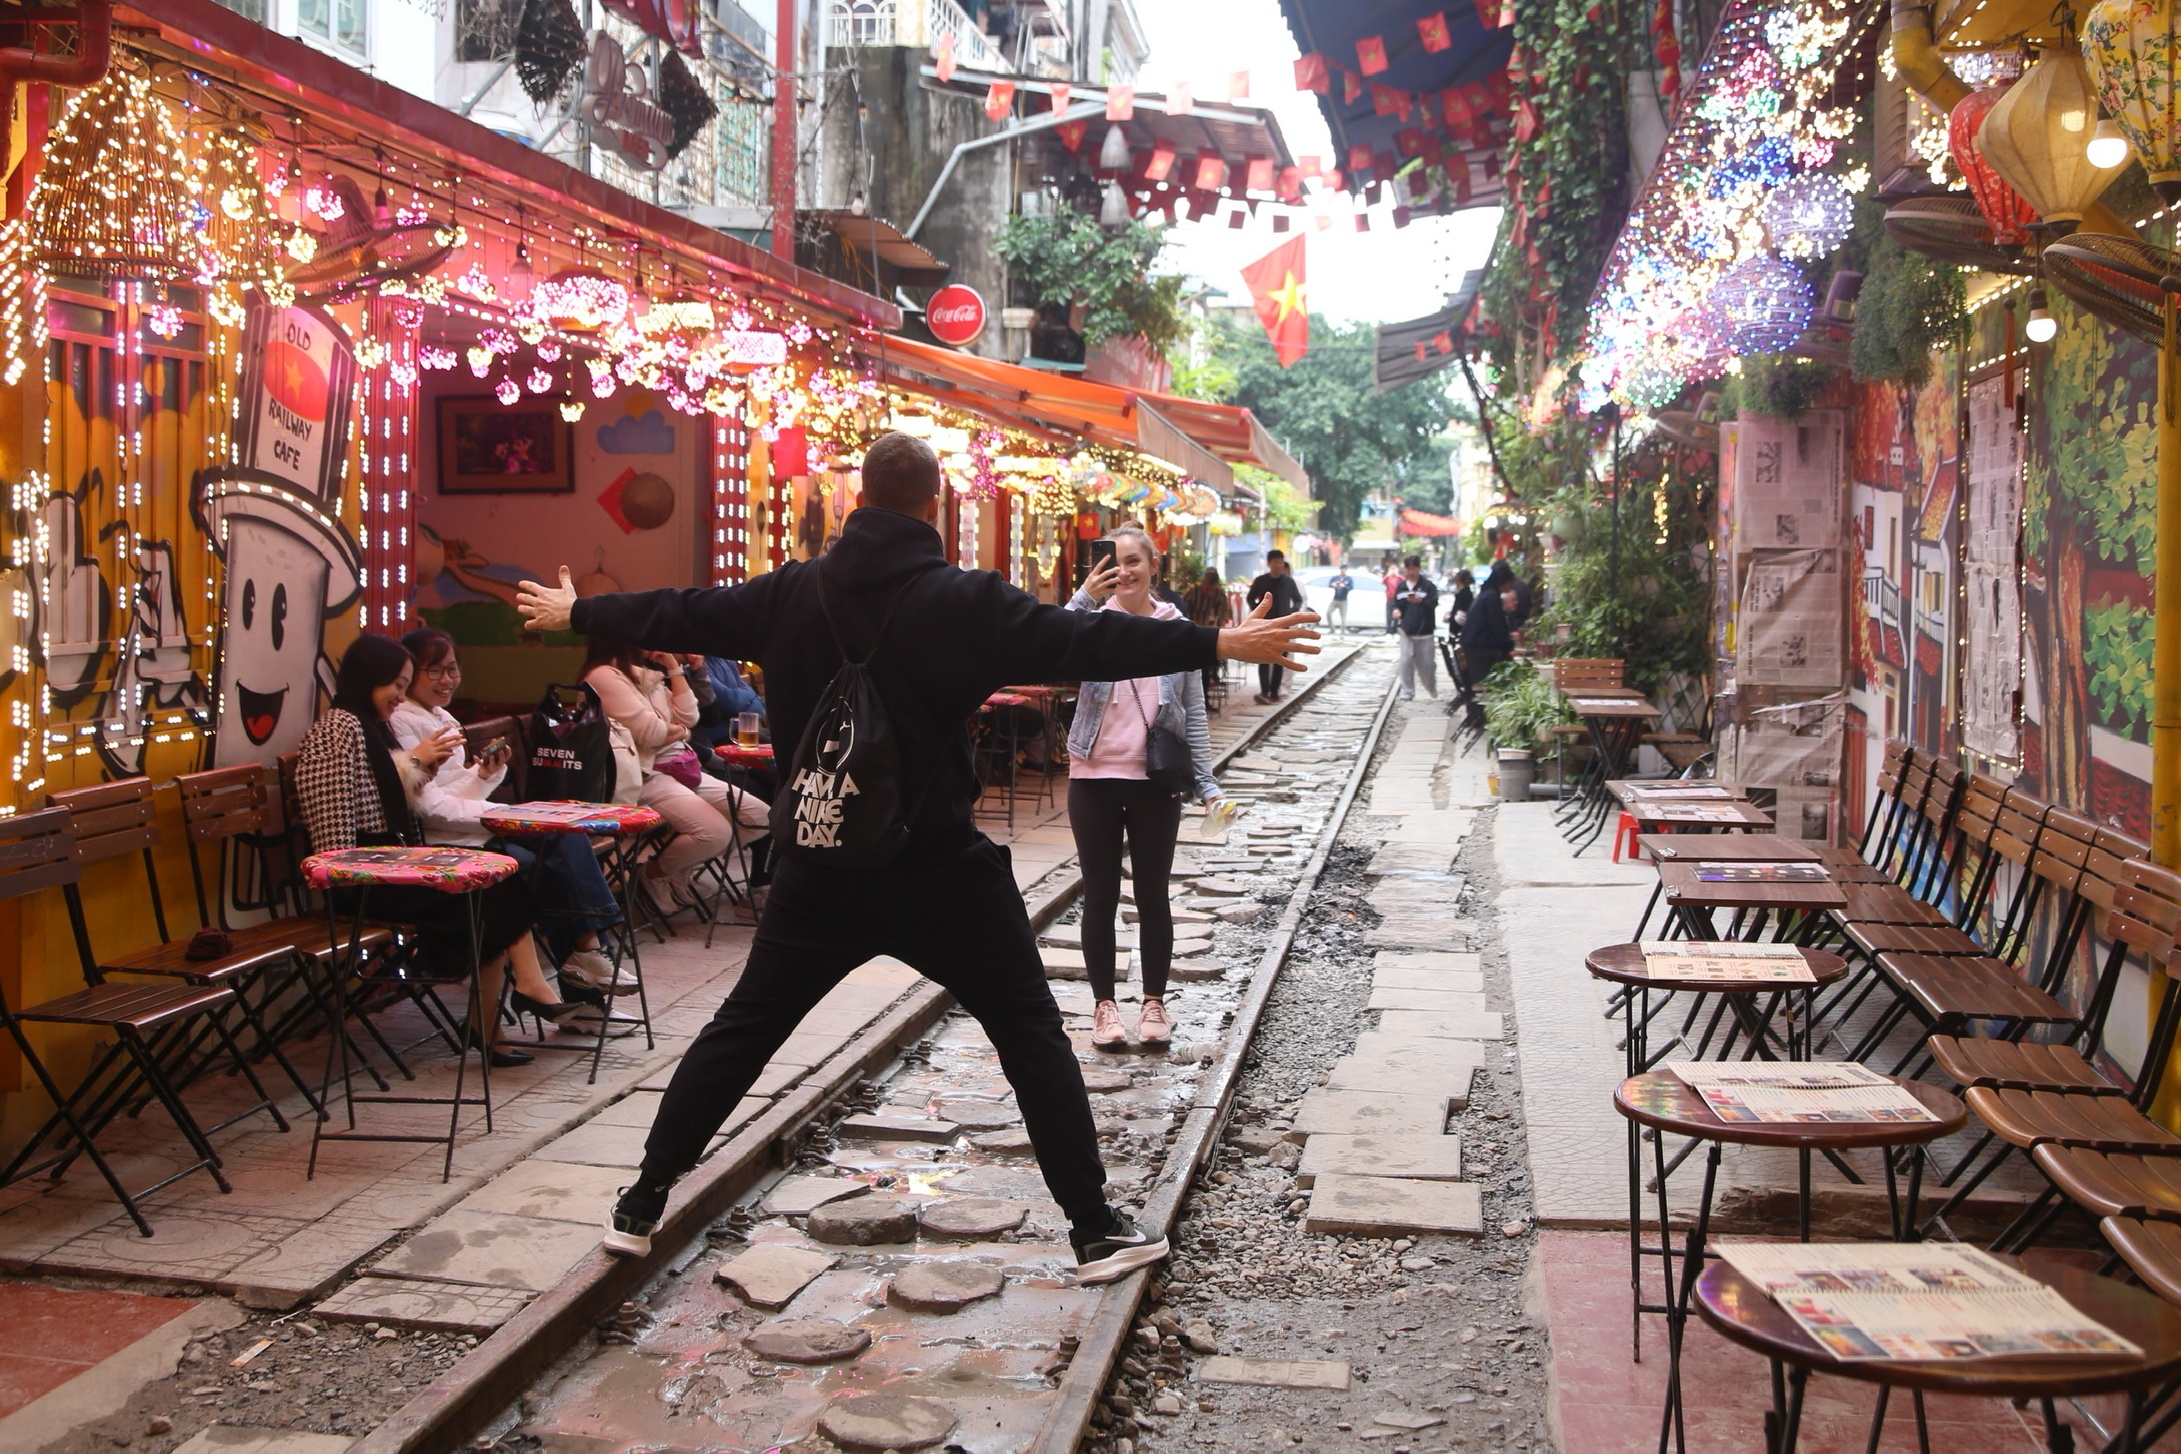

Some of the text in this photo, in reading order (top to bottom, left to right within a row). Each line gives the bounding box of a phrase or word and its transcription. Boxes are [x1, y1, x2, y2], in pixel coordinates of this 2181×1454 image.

[287, 322, 312, 351] OLD
[268, 397, 313, 443] RAILWAY
[273, 439, 302, 472] CAFE
[537, 747, 575, 760] SEVEN
[837, 771, 861, 799] A
[793, 796, 844, 825] NIKE
[796, 820, 843, 849] DAY.
